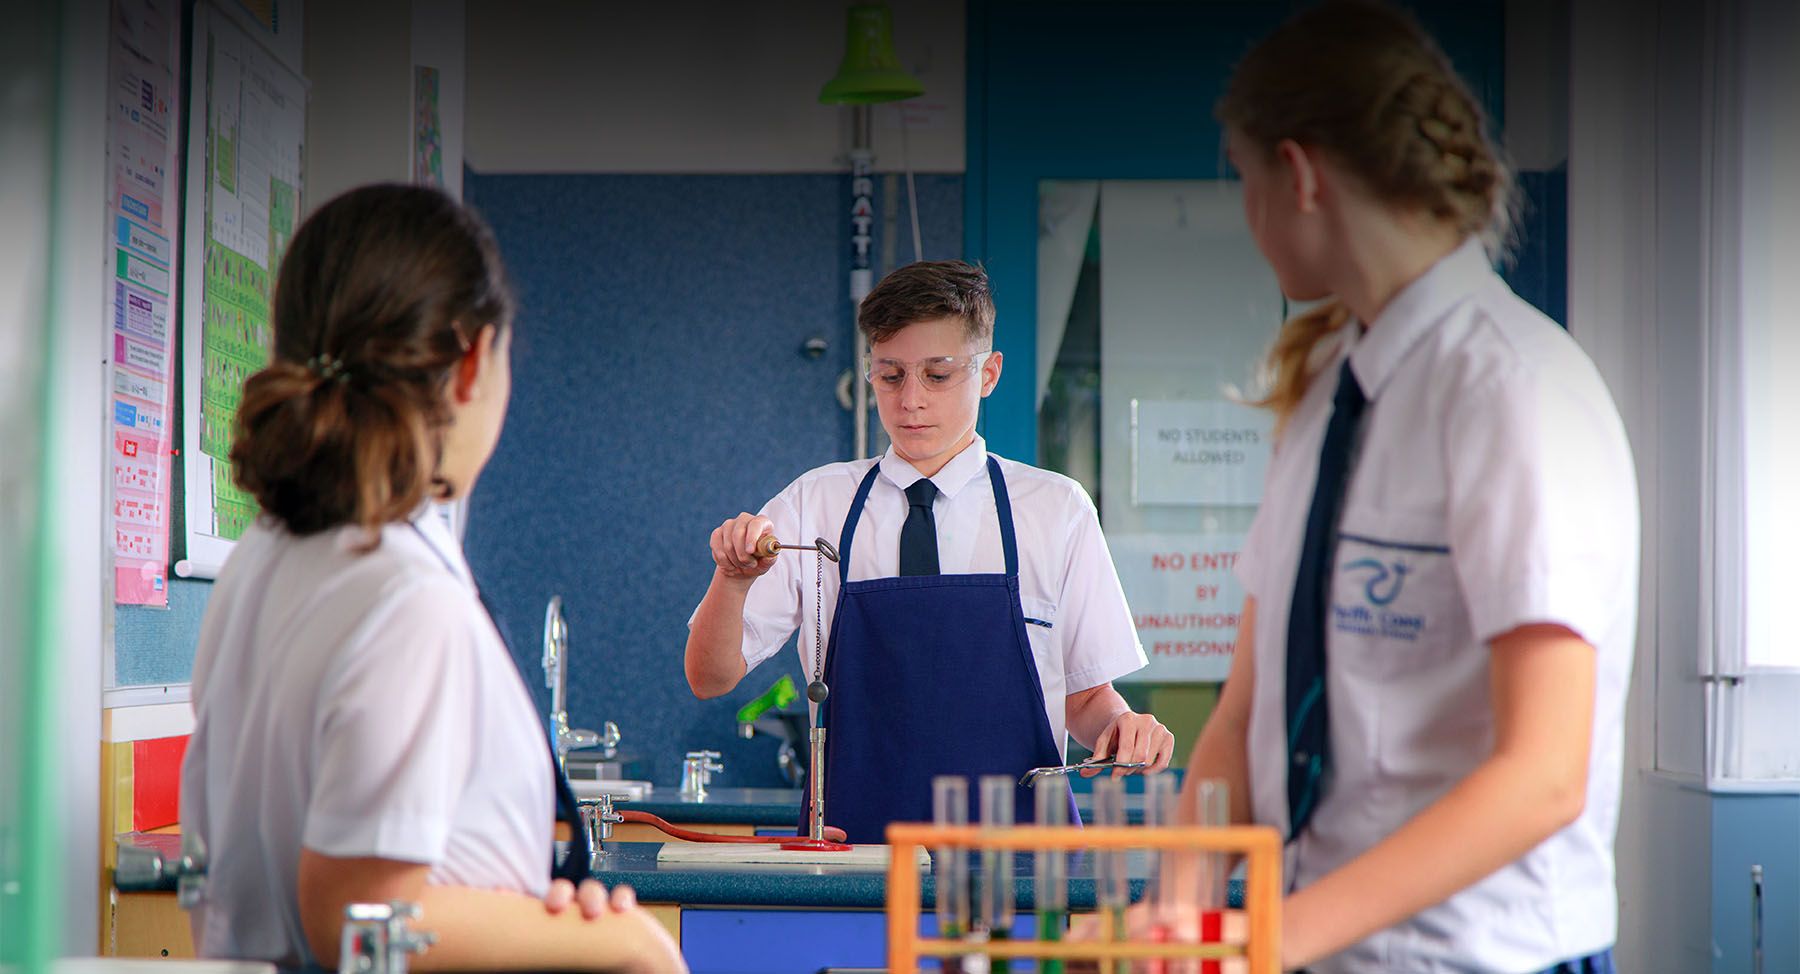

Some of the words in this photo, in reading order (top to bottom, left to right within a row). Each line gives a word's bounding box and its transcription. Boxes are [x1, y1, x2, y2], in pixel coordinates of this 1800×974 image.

[1158, 428, 1181, 443] NO
[1184, 428, 1260, 443] STUDENTS
[1173, 449, 1246, 465] ALLOWED
[1152, 552, 1185, 572] NO
[1196, 584, 1220, 602] BY
